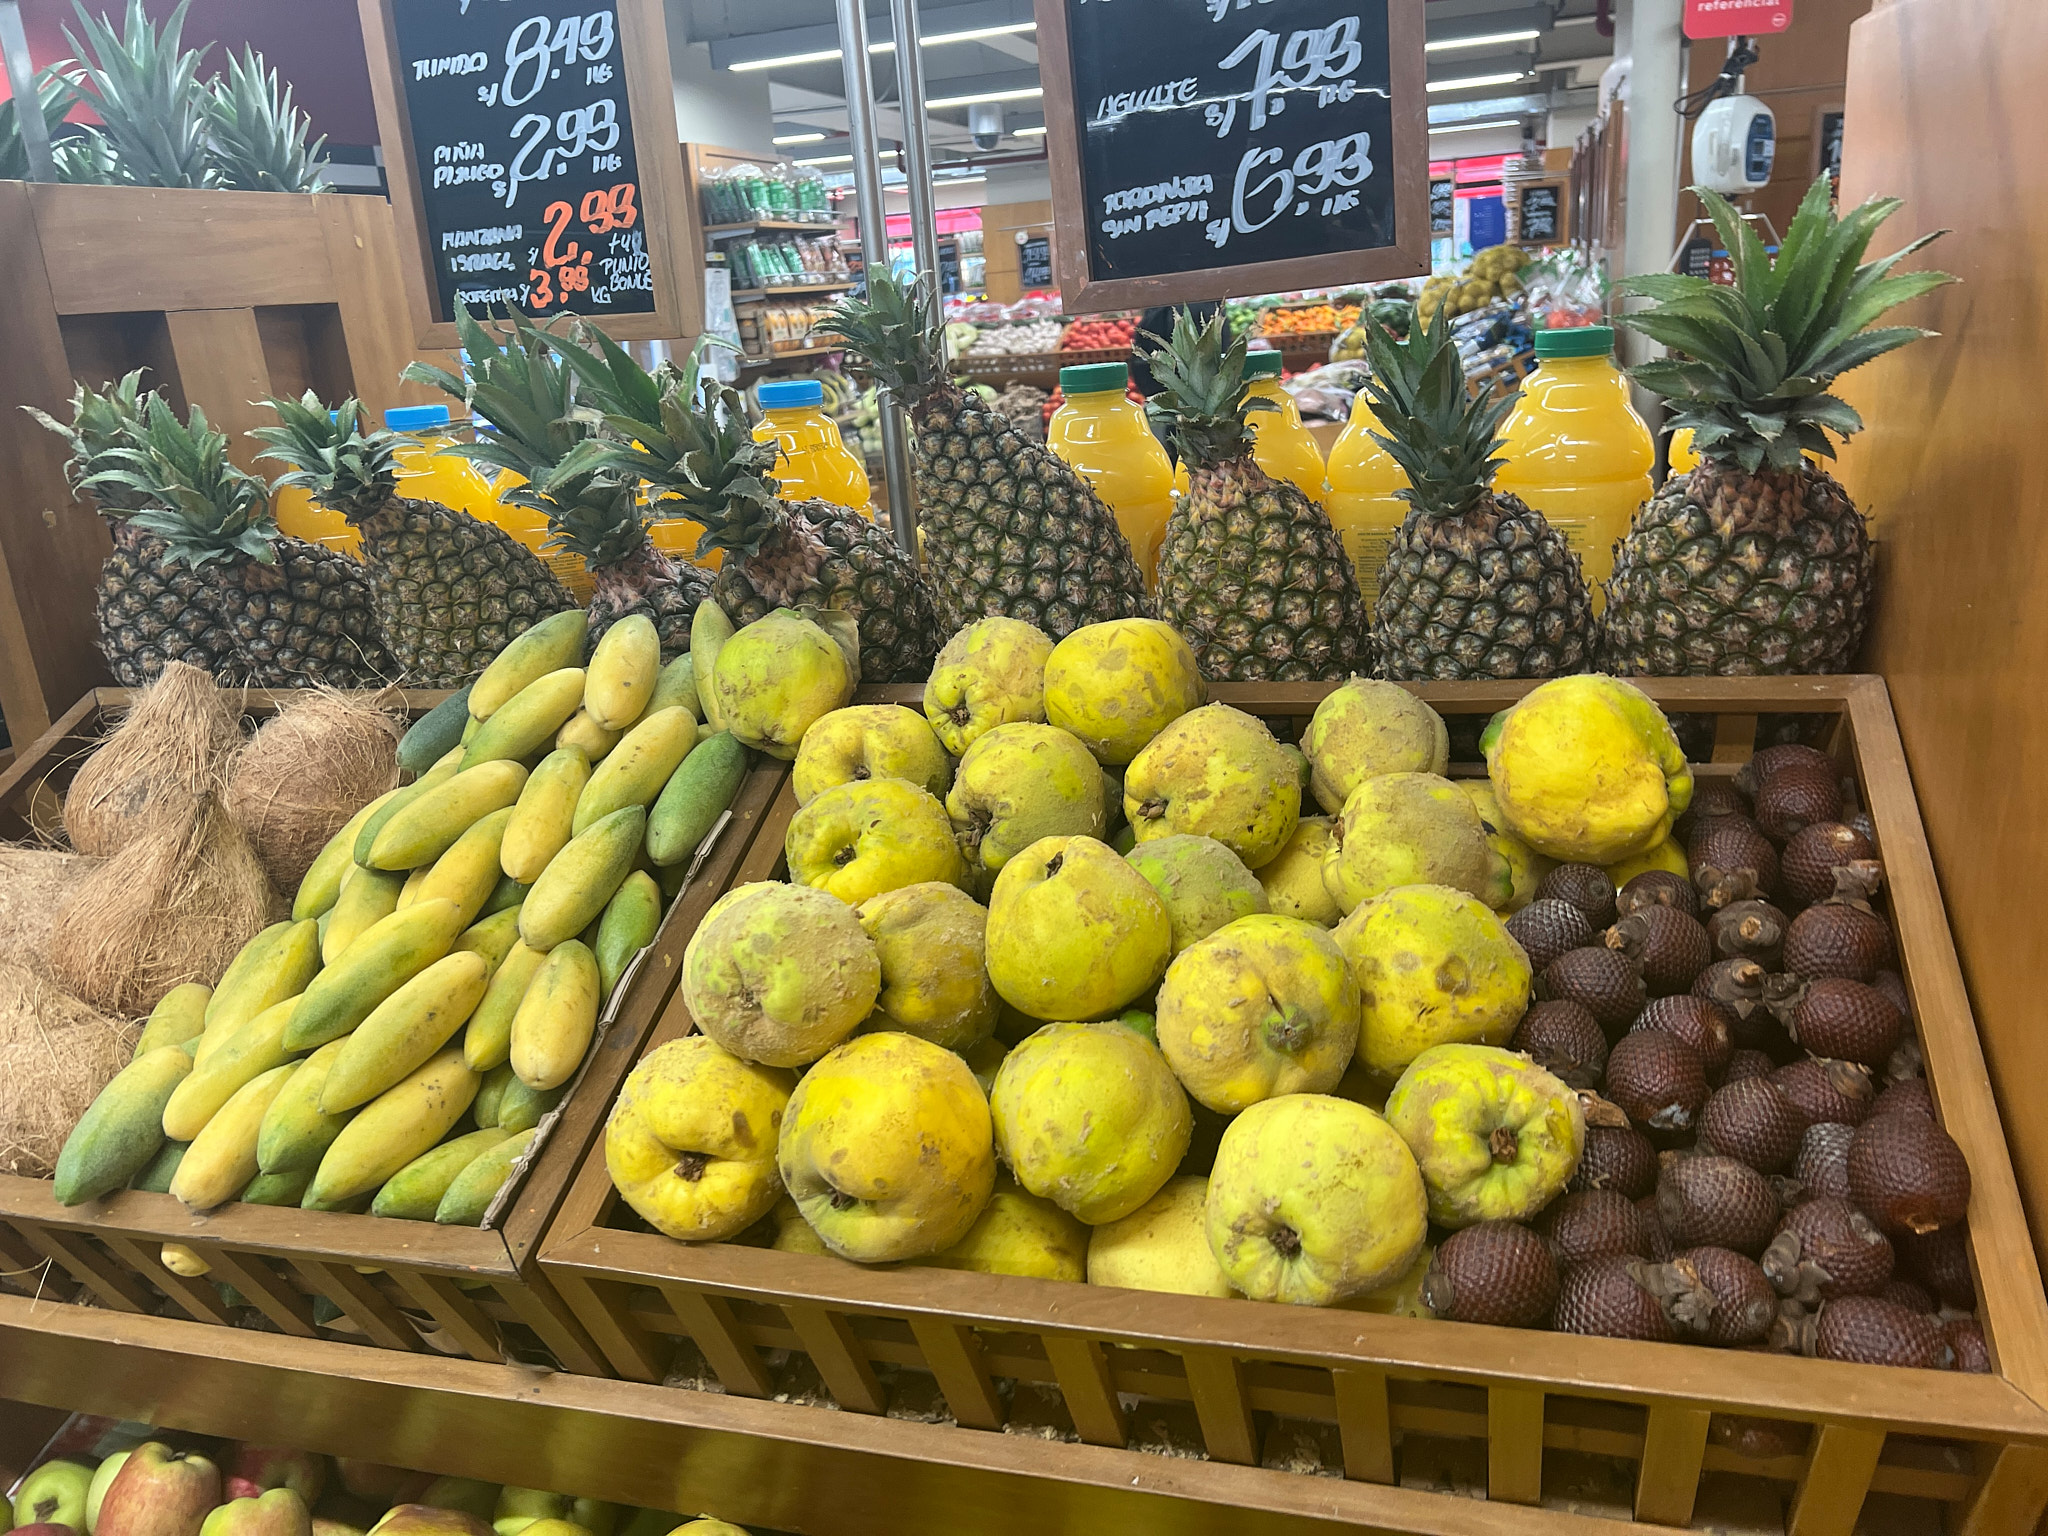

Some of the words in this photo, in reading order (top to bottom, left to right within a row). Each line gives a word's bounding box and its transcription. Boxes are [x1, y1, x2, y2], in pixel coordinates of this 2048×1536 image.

[433, 141, 485, 165] PIÑA
[1102, 215, 1142, 239] SIN
[1145, 200, 1208, 231] PEPA
[442, 224, 523, 251] MANZANA
[451, 252, 516, 273] ISRAEL
[591, 286, 612, 303] KG
